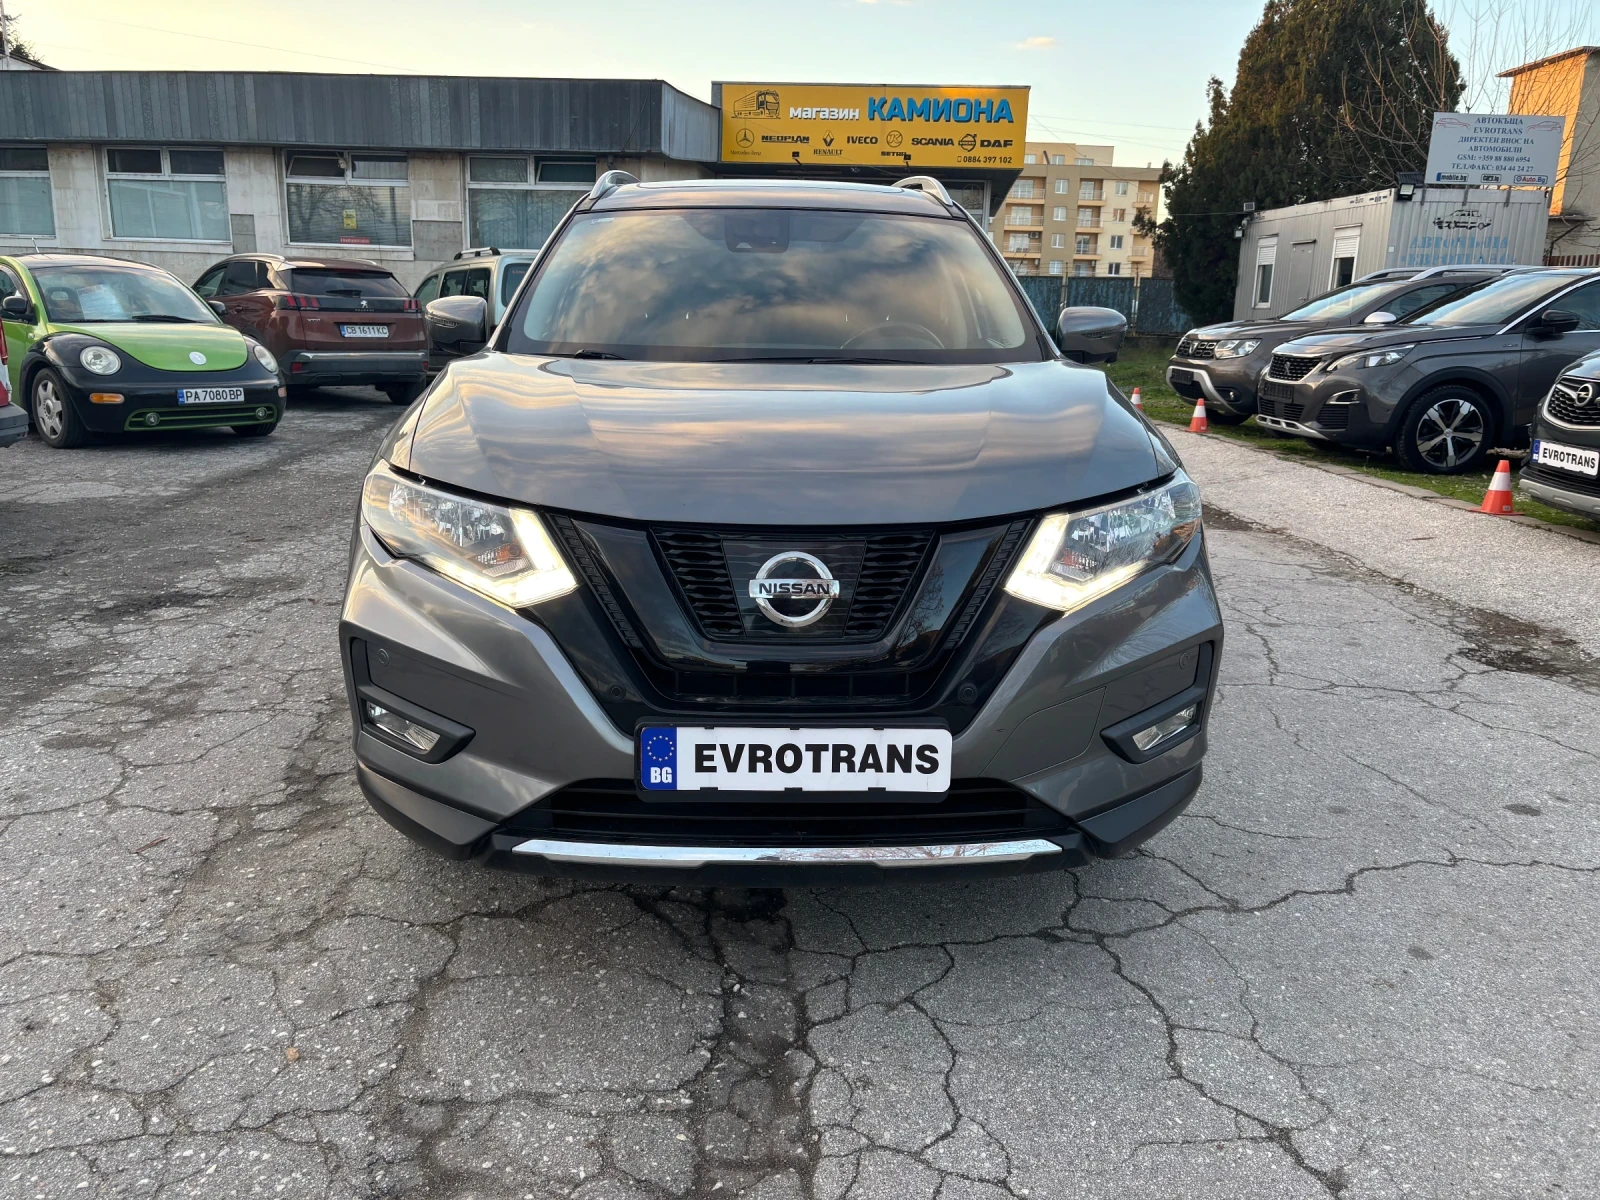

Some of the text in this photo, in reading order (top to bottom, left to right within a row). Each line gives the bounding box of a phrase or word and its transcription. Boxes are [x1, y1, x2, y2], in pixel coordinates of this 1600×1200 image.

[789, 96, 1014, 123] магазин КАМИОНА
[1473, 127, 1523, 135] EVROTRANS
[761, 135, 810, 143] NEOPLAN
[846, 135, 878, 144] IVECO
[911, 137, 955, 146] SCANIA
[979, 139, 1014, 148] DAF
[1458, 136, 1500, 144] ДИРЕКТЕН
[1500, 137, 1523, 145] ВНОС
[962, 155, 1013, 164] 0884 397 102
[1542, 447, 1596, 469] EVROTRANS
[758, 582, 830, 595] NISSAN
[694, 743, 940, 774] EVROTRANS
[650, 766, 673, 784] BG
